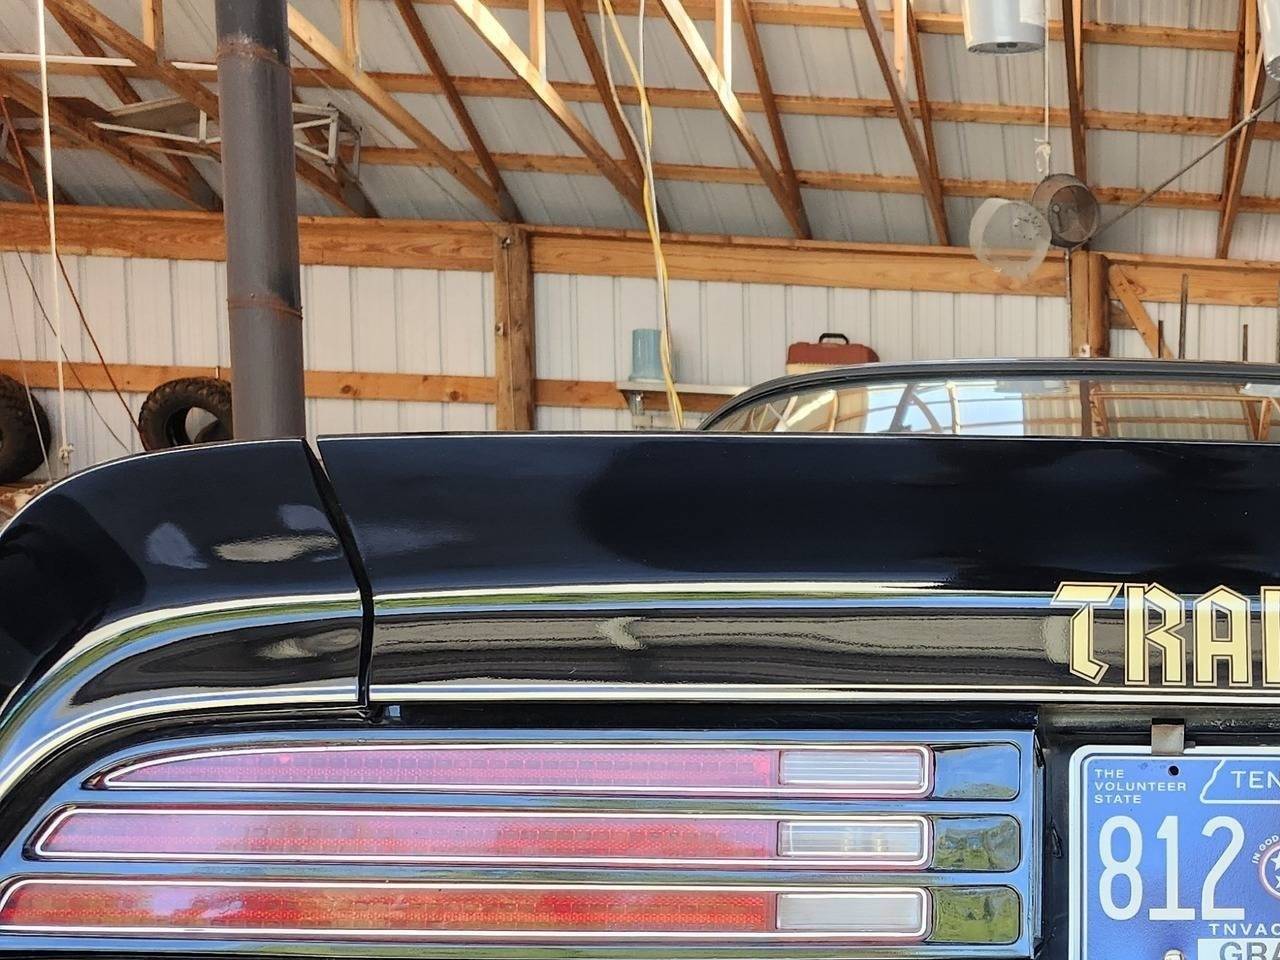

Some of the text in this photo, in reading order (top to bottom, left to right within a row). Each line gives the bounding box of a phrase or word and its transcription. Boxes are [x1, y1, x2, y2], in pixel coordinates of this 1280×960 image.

[1094, 769, 1125, 779] THE
[1094, 782, 1187, 792] VOLUNTEER
[1094, 794, 1142, 804] STATE
[1252, 852, 1261, 864] IN
[1259, 834, 1279, 851] GOD
[1099, 815, 1246, 922] 812
